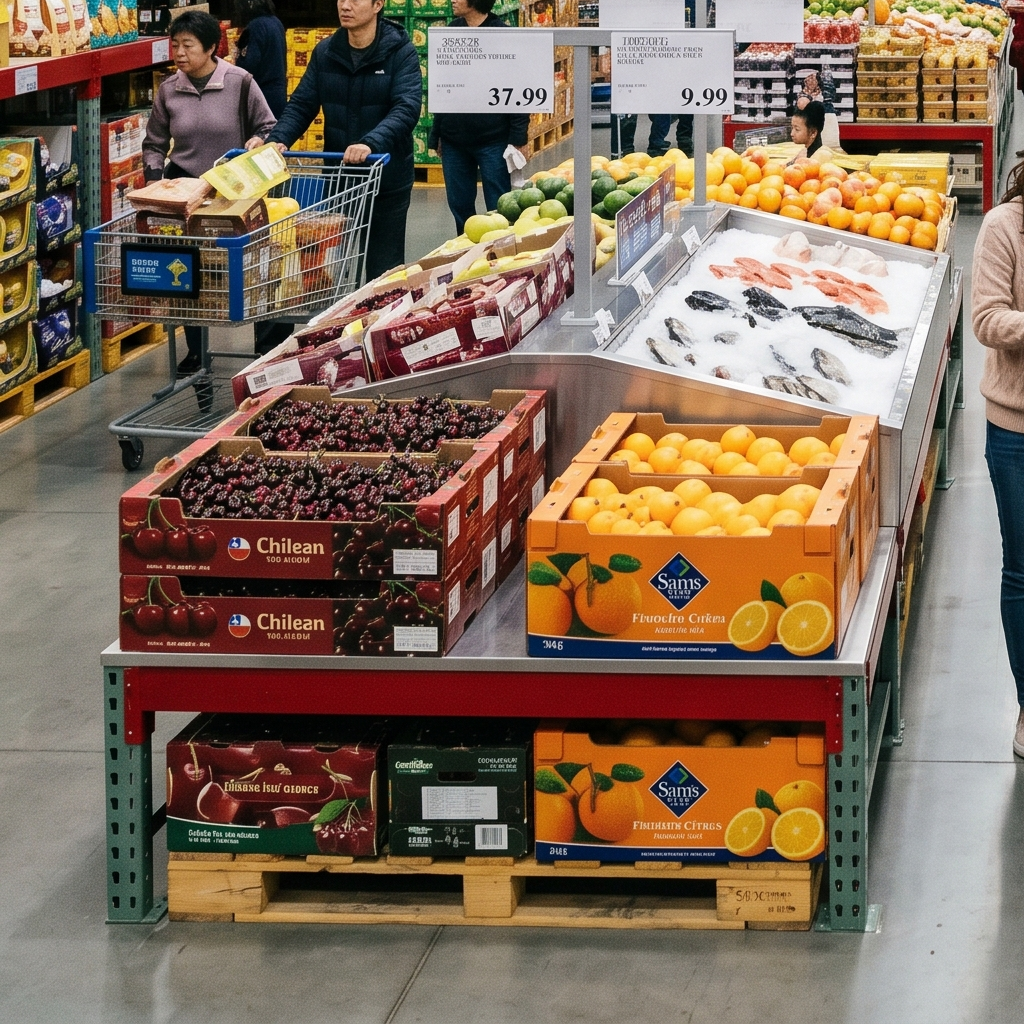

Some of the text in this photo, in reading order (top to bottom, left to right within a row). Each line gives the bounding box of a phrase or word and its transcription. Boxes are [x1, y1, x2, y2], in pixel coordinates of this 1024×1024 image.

[488, 87, 548, 107] 37.99
[681, 87, 728, 107] 9.99
[256, 536, 325, 555] Chilean
[657, 572, 702, 590] Sams
[256, 612, 325, 632] Chilean
